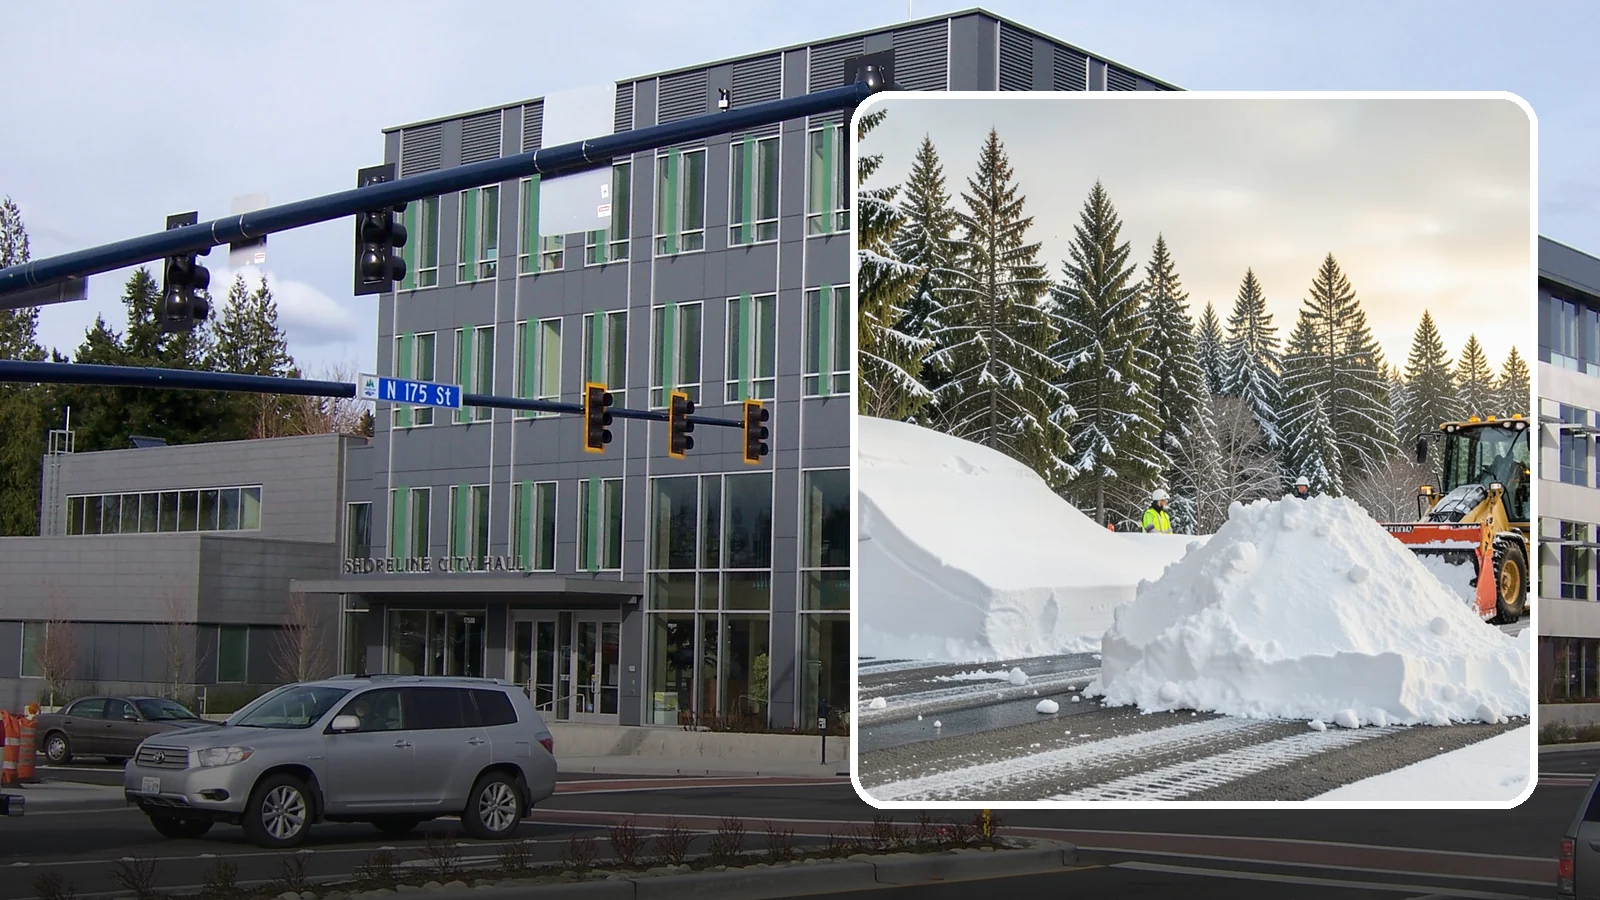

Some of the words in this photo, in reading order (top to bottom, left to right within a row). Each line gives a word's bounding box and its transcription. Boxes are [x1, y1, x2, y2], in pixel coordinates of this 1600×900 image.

[387, 380, 396, 400] N
[405, 382, 427, 403] 175
[436, 386, 451, 406] St
[343, 557, 432, 574] SHORELINE
[438, 556, 475, 572] CITY
[484, 555, 525, 571] HALL
